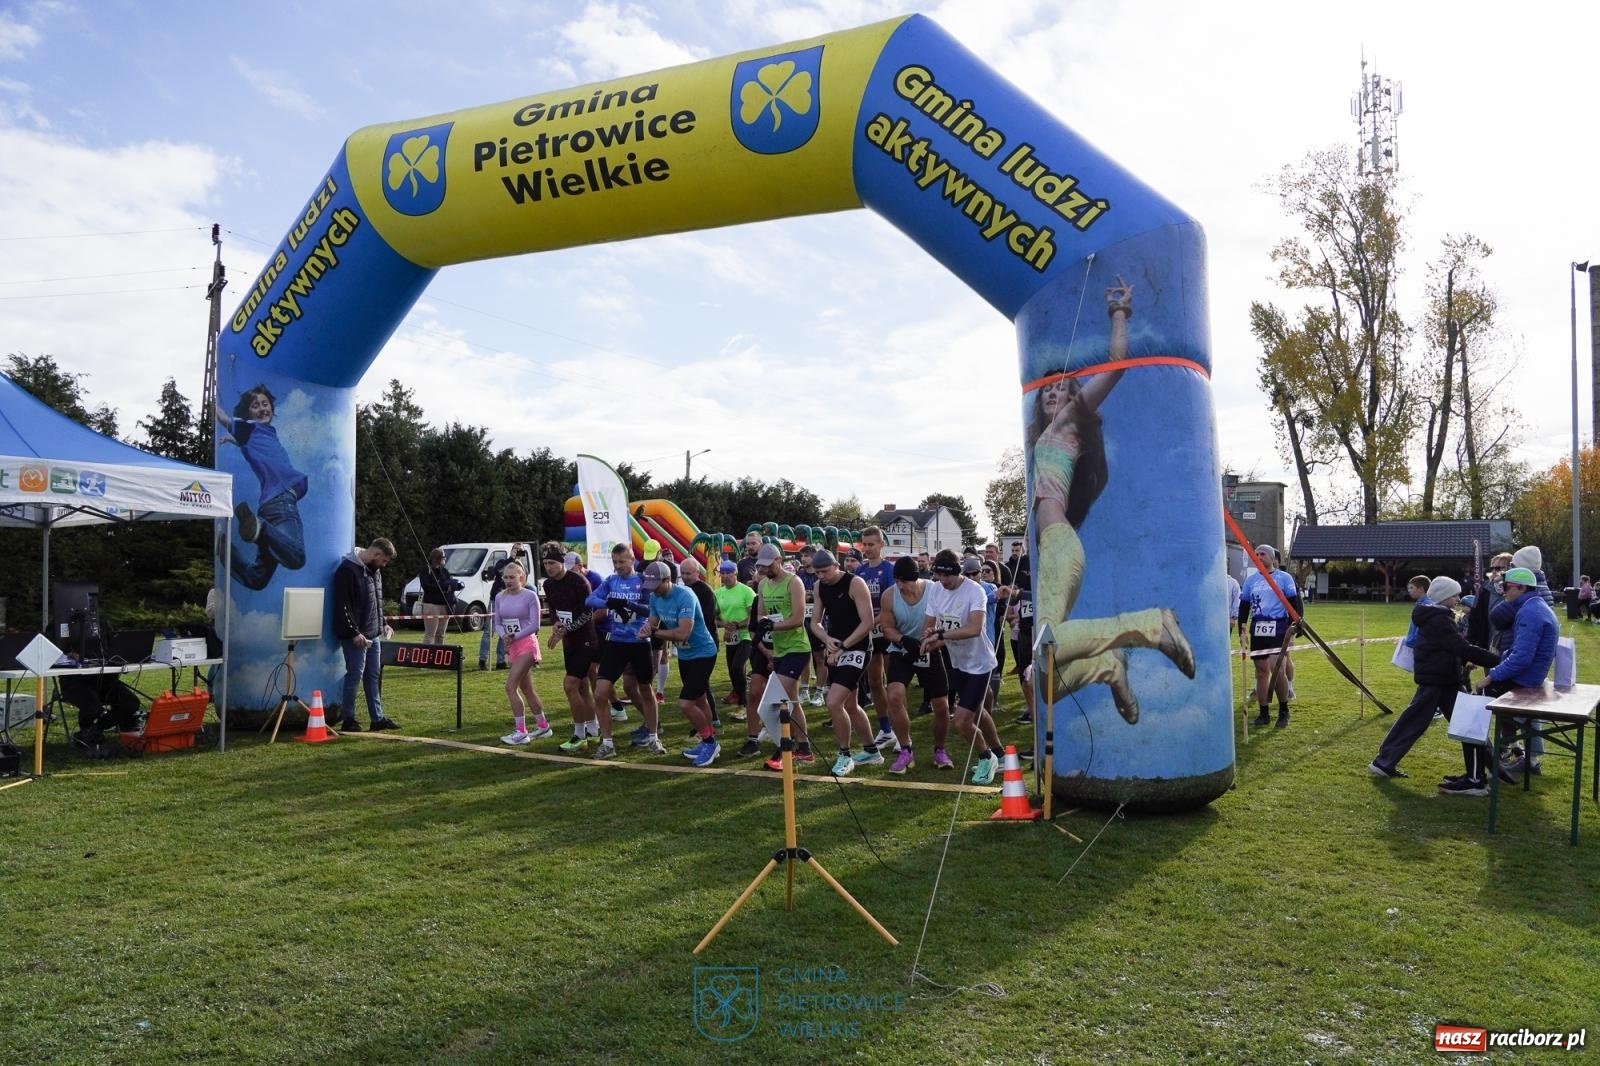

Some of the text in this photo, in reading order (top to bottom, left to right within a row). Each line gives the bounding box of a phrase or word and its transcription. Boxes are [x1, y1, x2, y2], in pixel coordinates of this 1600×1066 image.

[512, 83, 659, 127] Gmina
[473, 108, 697, 172] Pietrowice
[893, 64, 1111, 232] Gmina ludzi
[501, 152, 670, 205] Wielkie
[865, 112, 1057, 273] aktywnych
[231, 176, 338, 333] Gmina ludzi
[251, 207, 361, 358] aktywnych
[180, 492, 211, 503] MITKO
[397, 647, 453, 666] 0:00:00
[1256, 626, 1275, 634] 767
[840, 654, 863, 665] 736
